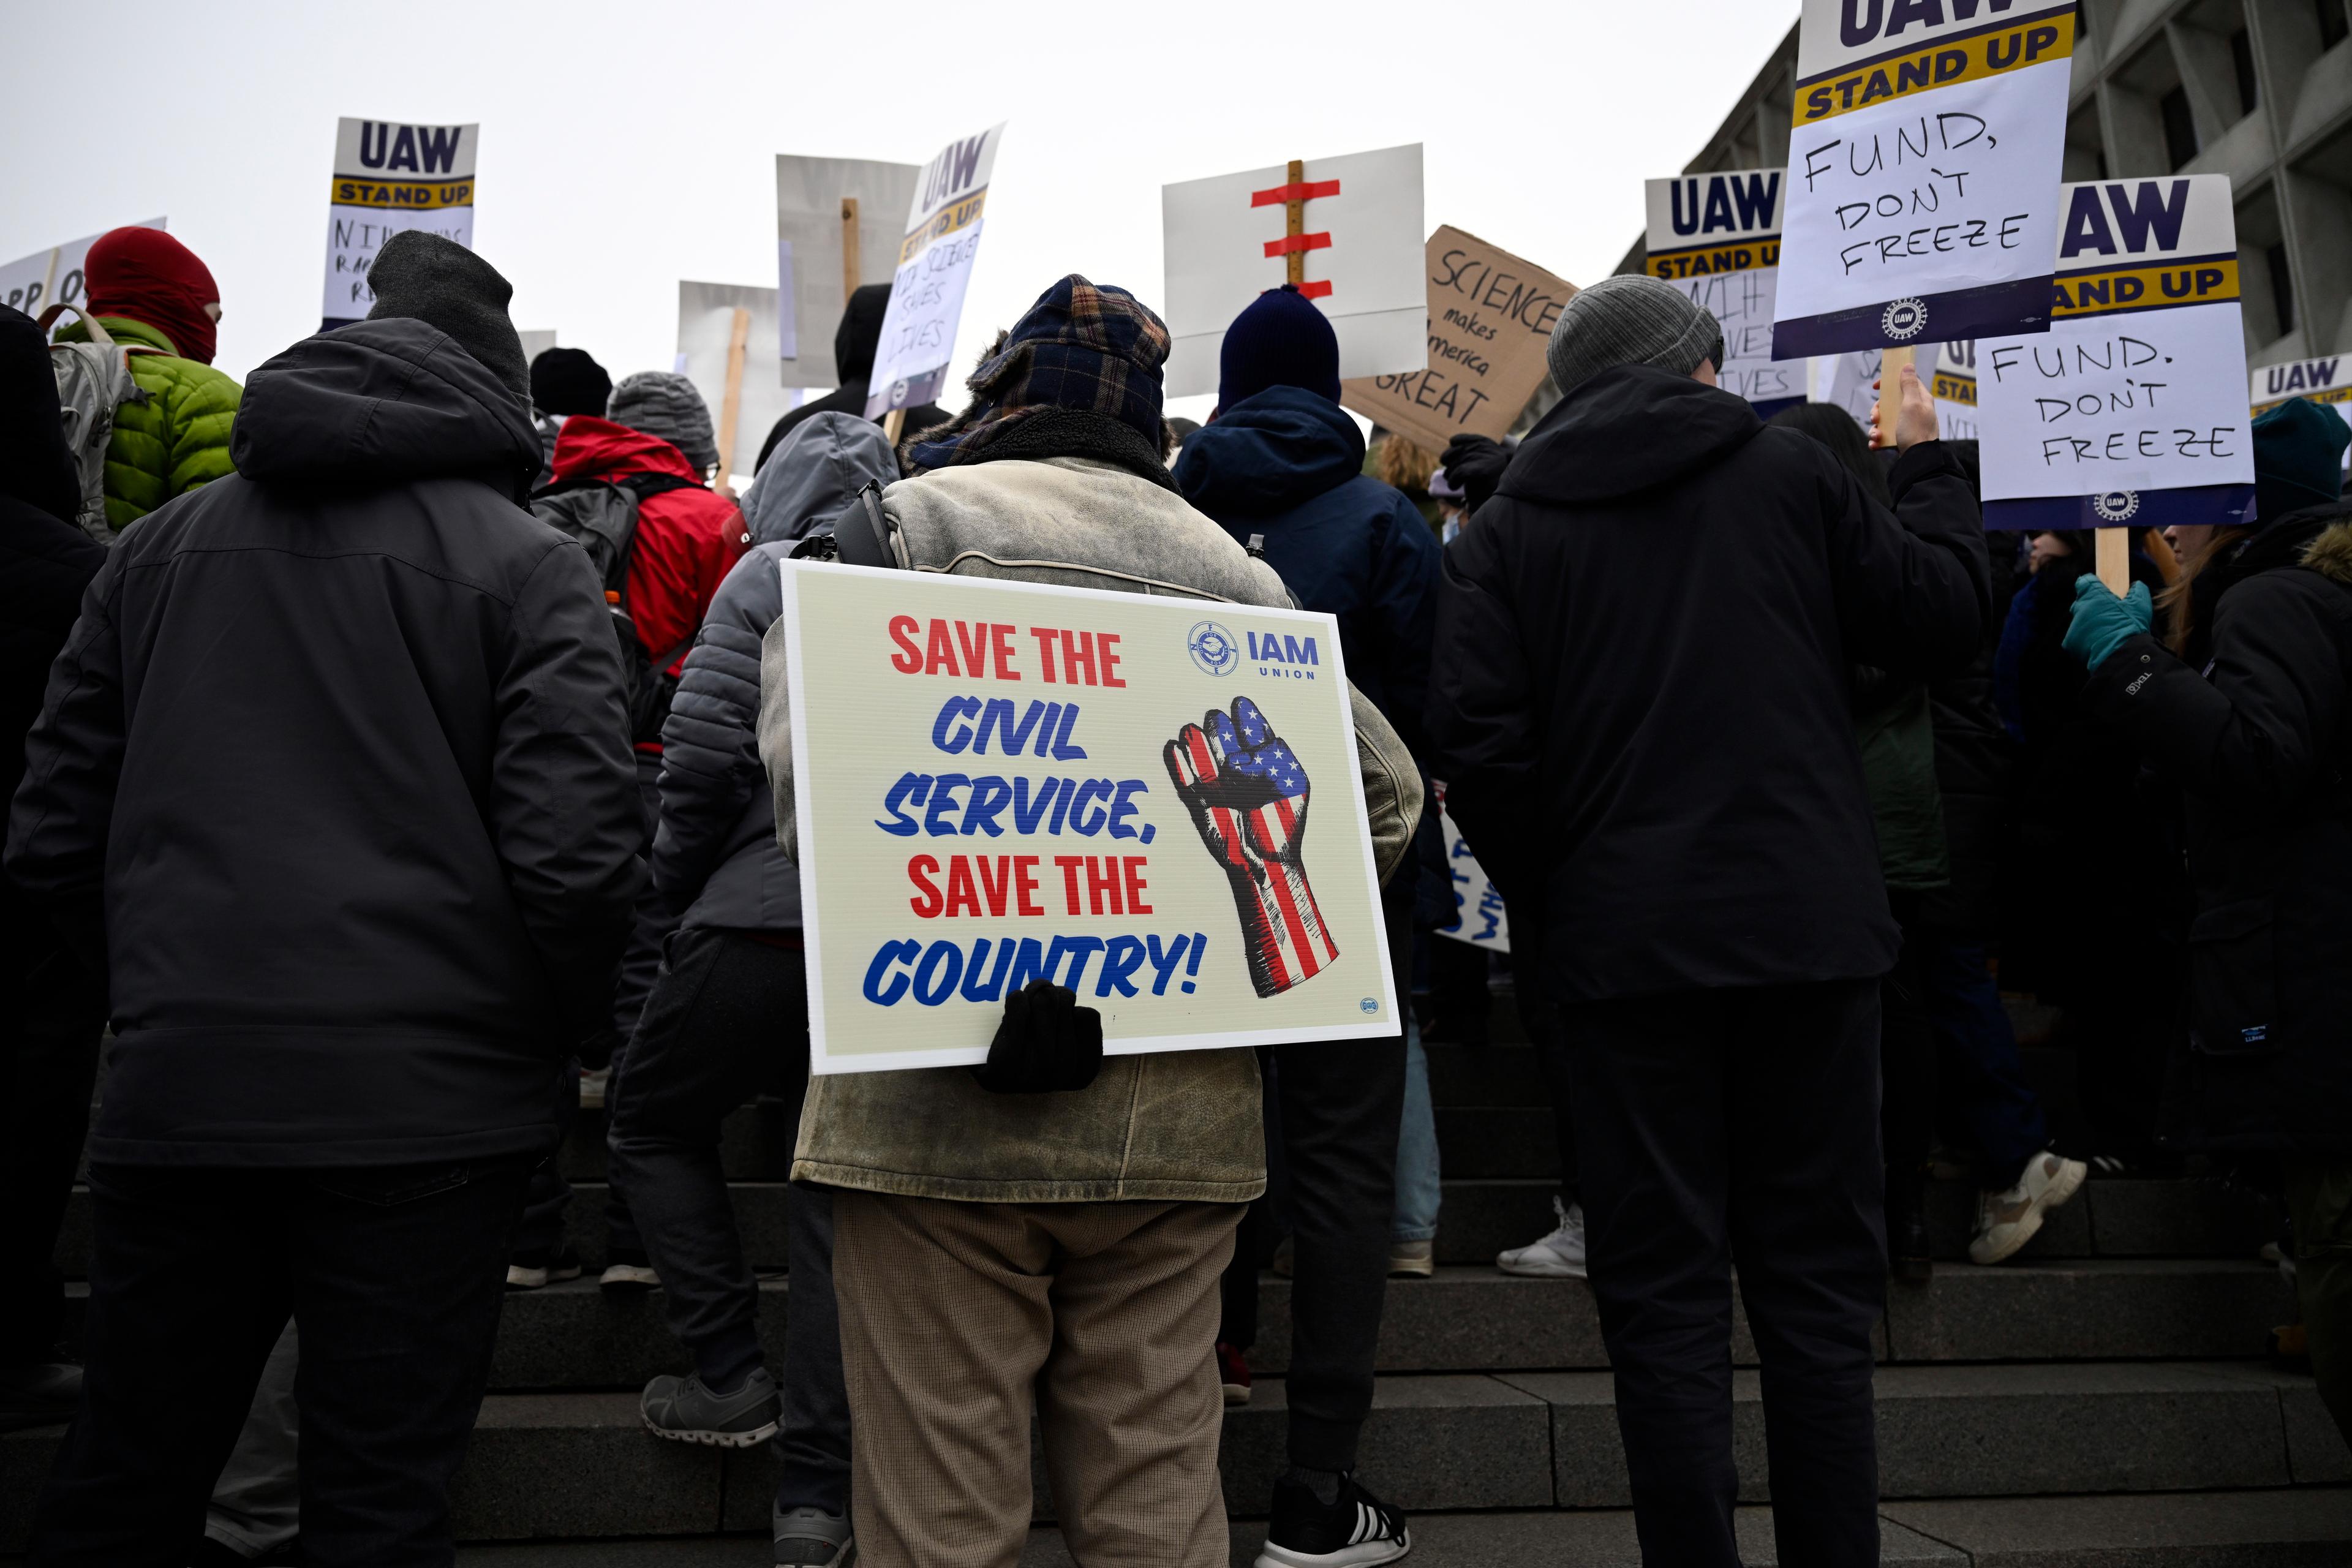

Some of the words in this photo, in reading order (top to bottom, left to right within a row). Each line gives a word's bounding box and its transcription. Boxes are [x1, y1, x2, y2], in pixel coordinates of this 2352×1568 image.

[1805, 50, 1968, 119] STAND
[1986, 26, 2058, 69] UP
[360, 120, 462, 174] UAW
[922, 129, 991, 214] UAW
[1806, 113, 1996, 192] FUND,
[340, 184, 431, 205] STAND
[440, 186, 470, 204] UP
[957, 199, 982, 227] UP
[1670, 172, 1781, 236] UAW
[1836, 168, 1969, 230] DON'T
[2060, 179, 2190, 258] AW
[1657, 249, 1752, 280] STAND
[1762, 246, 1779, 265] U
[1841, 214, 2029, 276] FREEZE
[1433, 250, 1566, 336] SCIENCE
[2052, 276, 2144, 307] AND
[2161, 269, 2224, 296] UP
[1443, 307, 1498, 341] makes
[1894, 312, 1913, 323] UAW
[1427, 320, 1490, 377] merica
[2268, 356, 2339, 394] UAW
[1937, 379, 1977, 405] STA
[2035, 379, 2166, 423] DON'T
[2043, 428, 2236, 466] FREEZE
[2106, 497, 2125, 507] UAW
[889, 615, 1021, 681] SAVE
[1030, 627, 1126, 688] THE
[1247, 631, 1319, 666] IAM
[1259, 667, 1315, 680] UNION
[932, 695, 1088, 761] CIVIL
[874, 772, 1156, 845] SERVICE,
[908, 854, 1044, 918] SAVE
[1054, 856, 1153, 915] THE
[1471, 881, 1505, 941] WH
[863, 932, 1207, 1006] COUNTRY!
